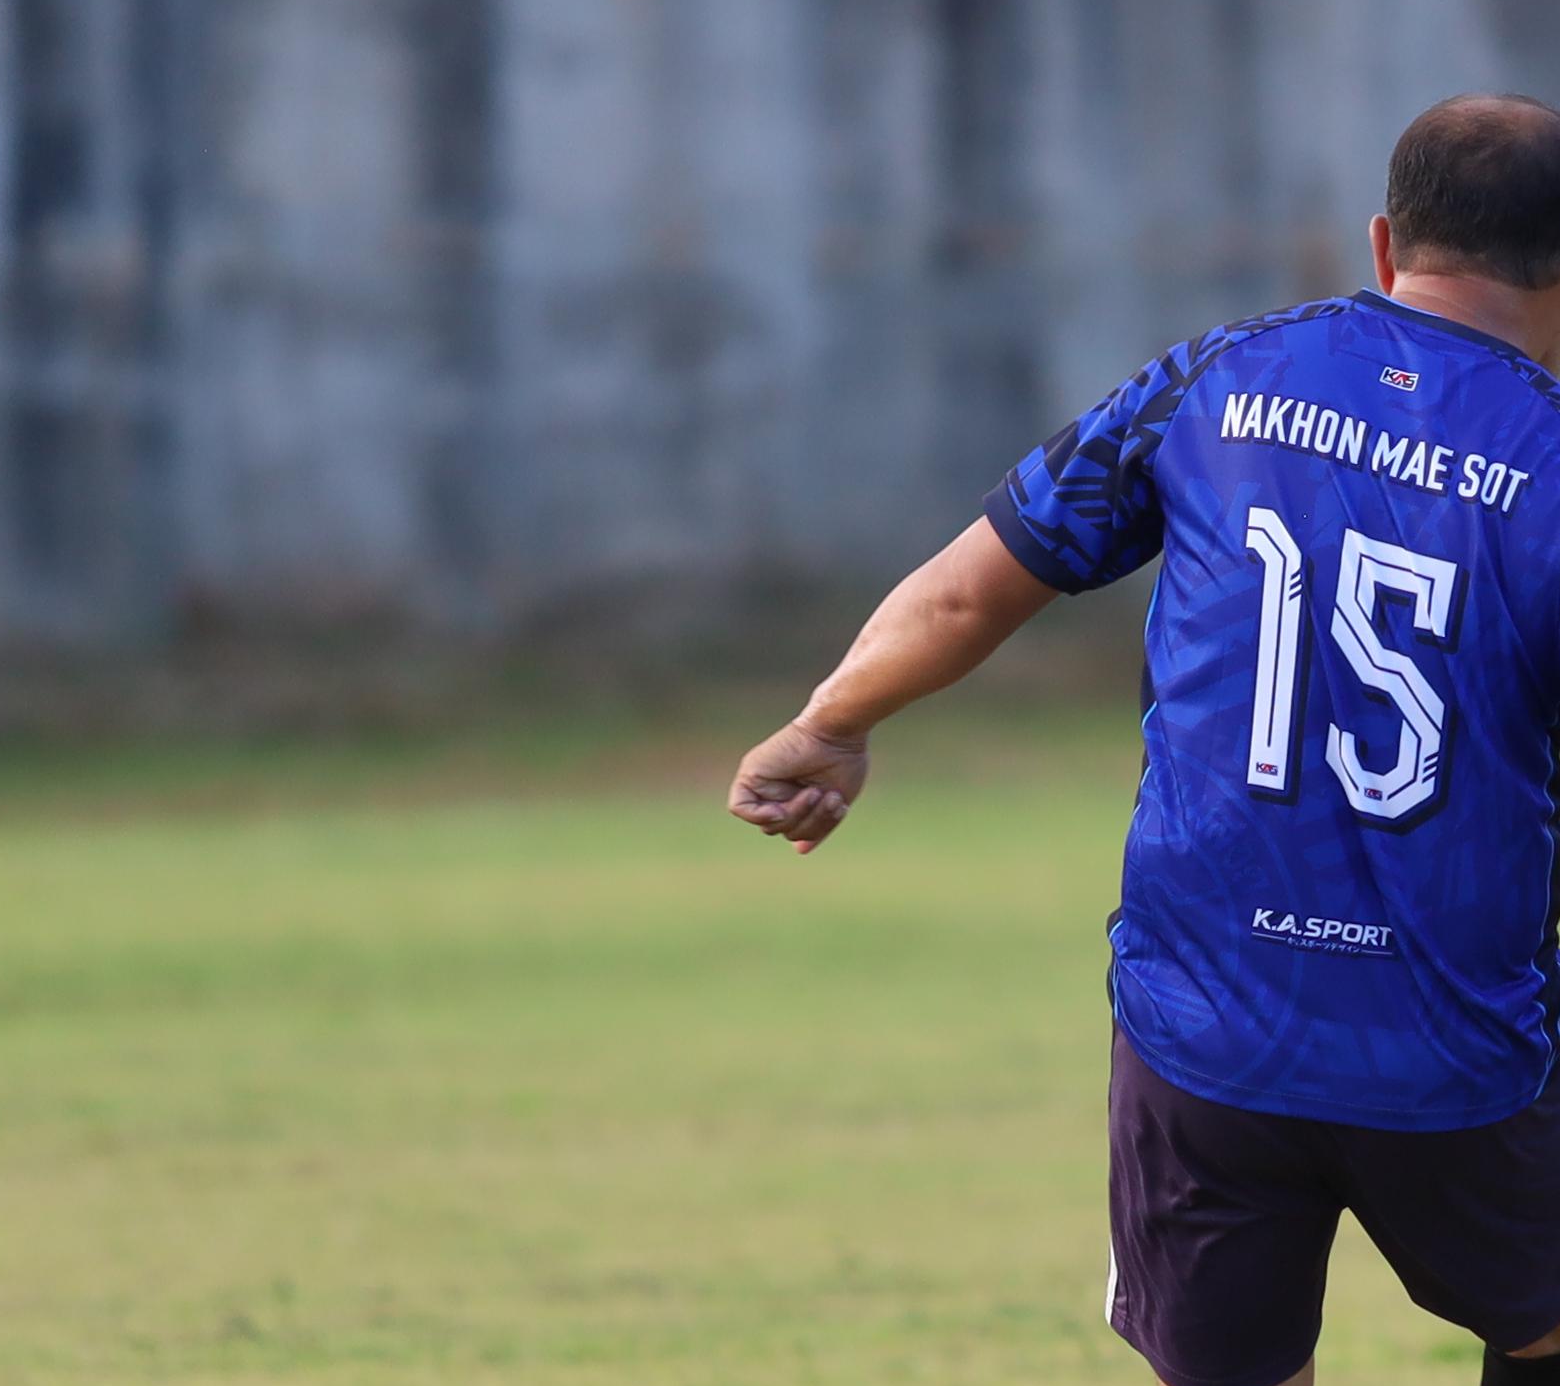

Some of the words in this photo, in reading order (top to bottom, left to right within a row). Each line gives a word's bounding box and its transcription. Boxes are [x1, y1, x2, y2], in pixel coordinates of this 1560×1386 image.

[1220, 393, 1367, 465] NAKHON
[1371, 430, 1454, 491] MAE
[1458, 453, 1529, 513] SOT
[1245, 506, 1457, 820] 15
[1252, 908, 1393, 946] K.A.SPORT
